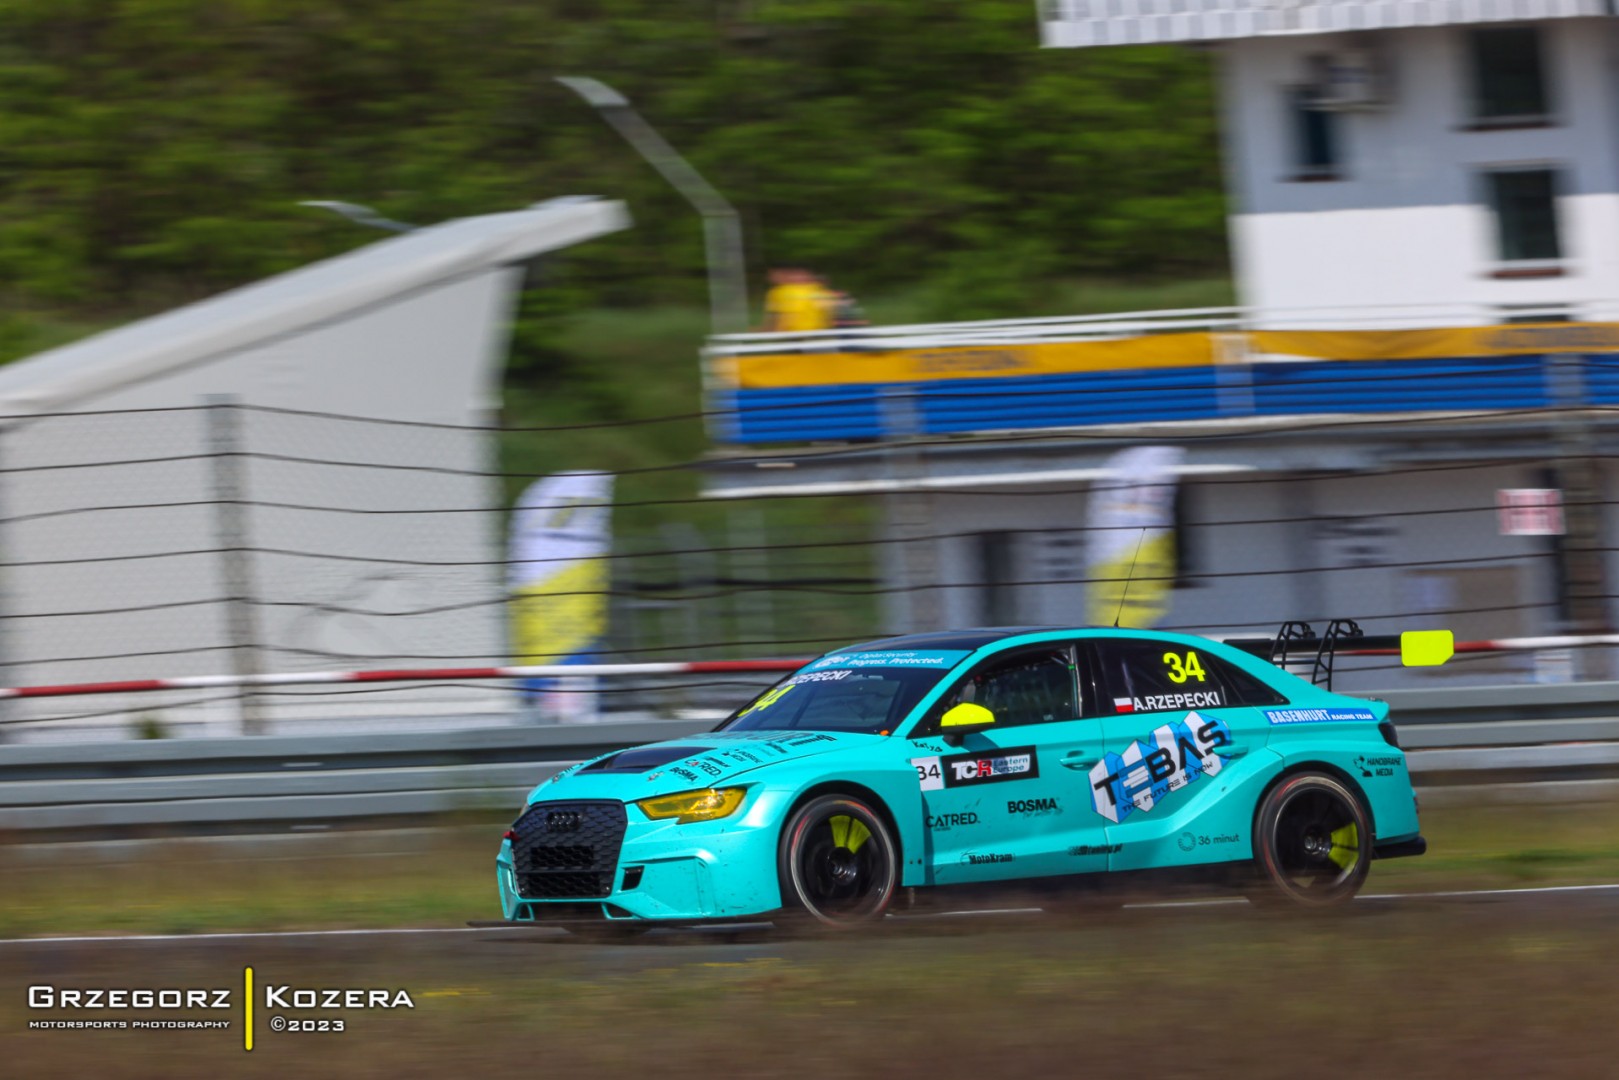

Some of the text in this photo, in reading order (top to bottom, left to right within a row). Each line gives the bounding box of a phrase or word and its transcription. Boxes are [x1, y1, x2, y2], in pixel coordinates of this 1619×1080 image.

[1163, 651, 1206, 684] 34
[1133, 691, 1221, 711] A.RZEPECKI
[1266, 709, 1331, 724] BASENHURT
[951, 757, 1029, 780] TCR Eastern
[992, 765, 1025, 774] Europe
[1122, 761, 1213, 812] THE FUTURE IS NOW
[1008, 798, 1057, 814] BOSMA
[925, 812, 978, 828] CATRED
[1198, 833, 1240, 845] 36 minut
